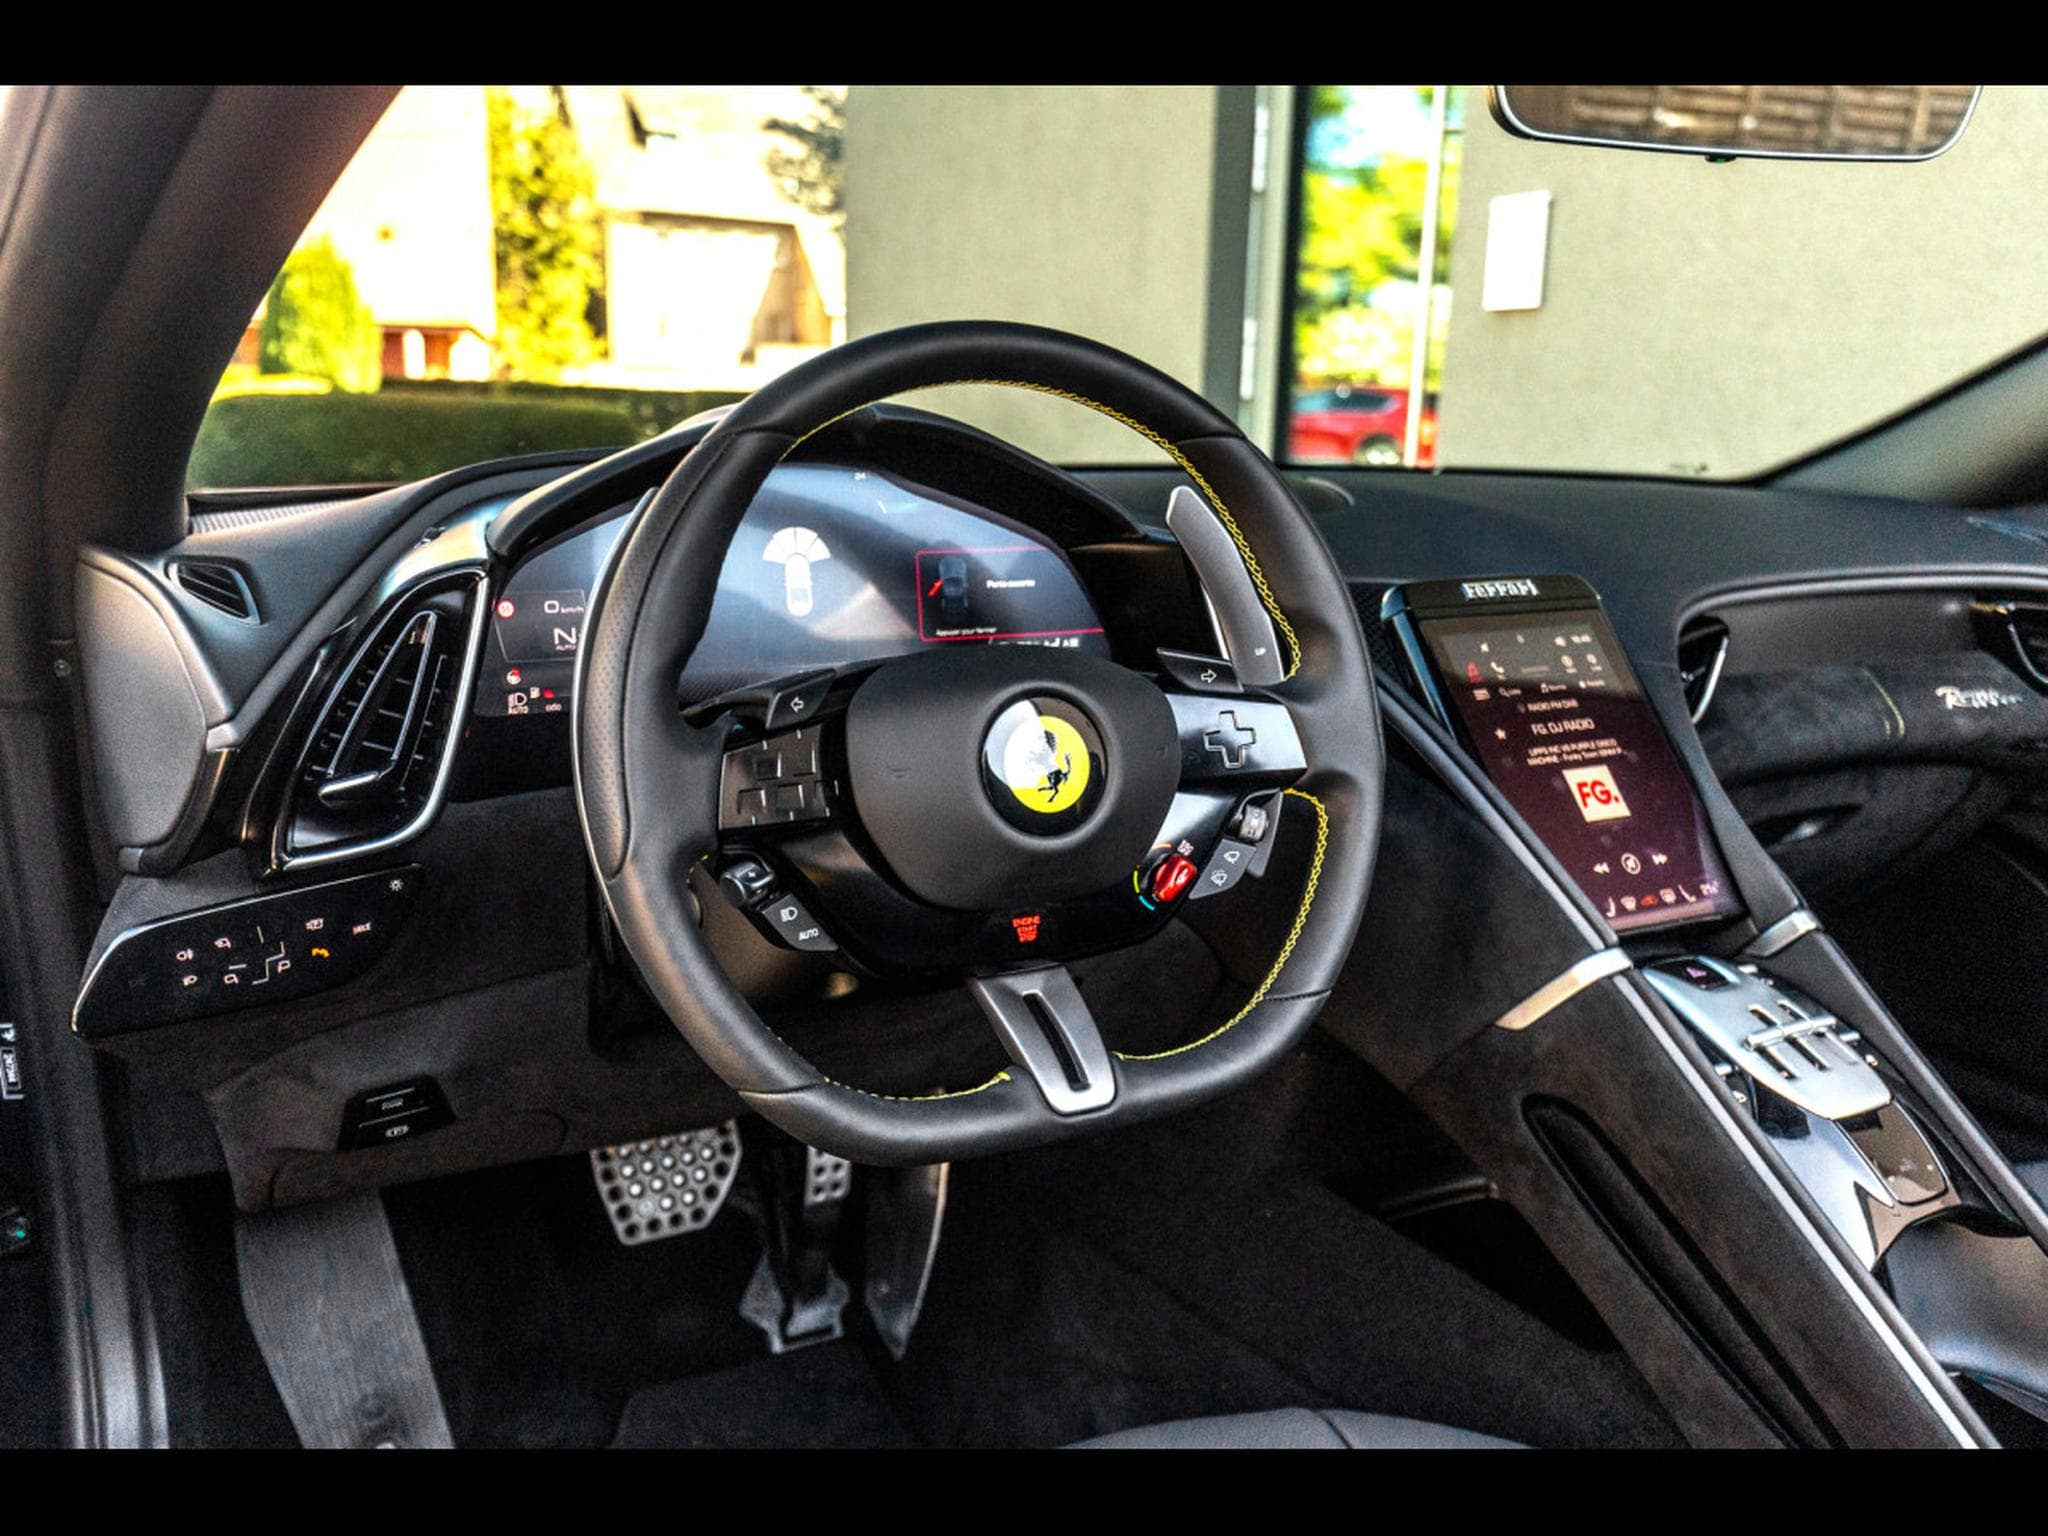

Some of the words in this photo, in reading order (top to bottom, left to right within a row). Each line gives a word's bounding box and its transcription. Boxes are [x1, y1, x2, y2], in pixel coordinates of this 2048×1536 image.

[1461, 579, 1539, 600] Ferrari
[553, 627, 577, 645] N
[1576, 780, 1620, 808] FG.
[799, 928, 819, 940] AUTO
